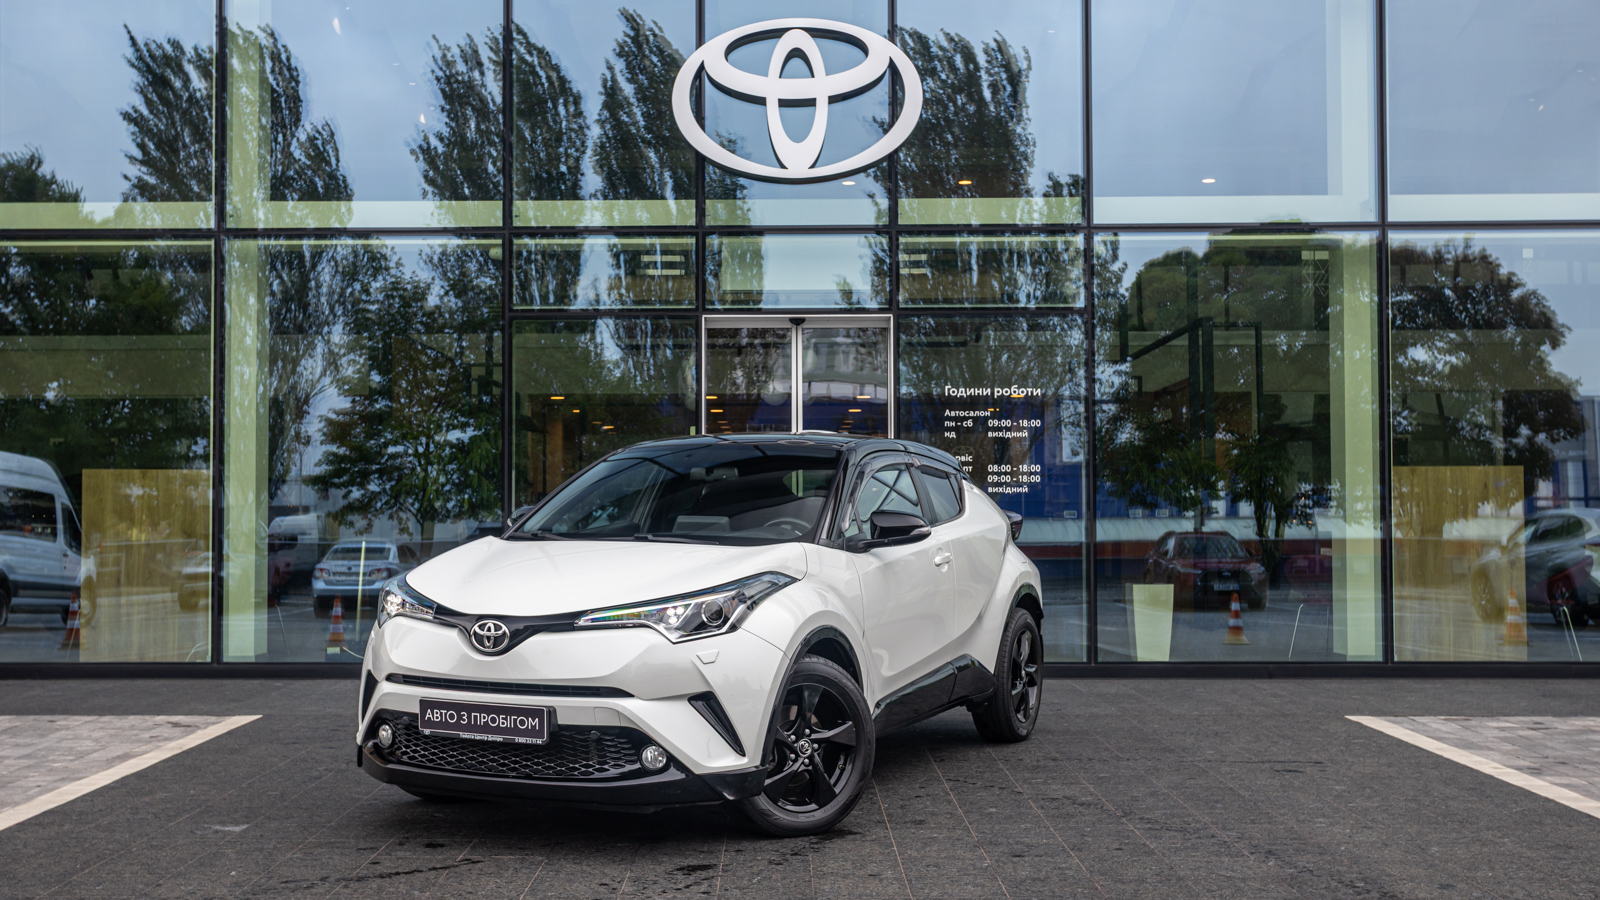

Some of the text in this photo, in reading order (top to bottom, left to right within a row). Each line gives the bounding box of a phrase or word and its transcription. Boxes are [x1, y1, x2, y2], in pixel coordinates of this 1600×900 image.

[944, 384, 1041, 398] Години роботи
[944, 409, 991, 417] Автосалон
[962, 419, 973, 427] сб
[987, 419, 1012, 427] 09:00
[1019, 419, 1041, 427] 18:00
[944, 429, 1028, 439] нд вихідний
[987, 464, 1012, 472] 08:00
[1019, 464, 1041, 472] 18:00
[987, 474, 1012, 483] 09:00
[1019, 474, 1041, 483] 18:00
[987, 485, 1029, 494] вихідний
[424, 708, 458, 724] АВТО
[471, 712, 539, 731] ПРОБІГОМ
